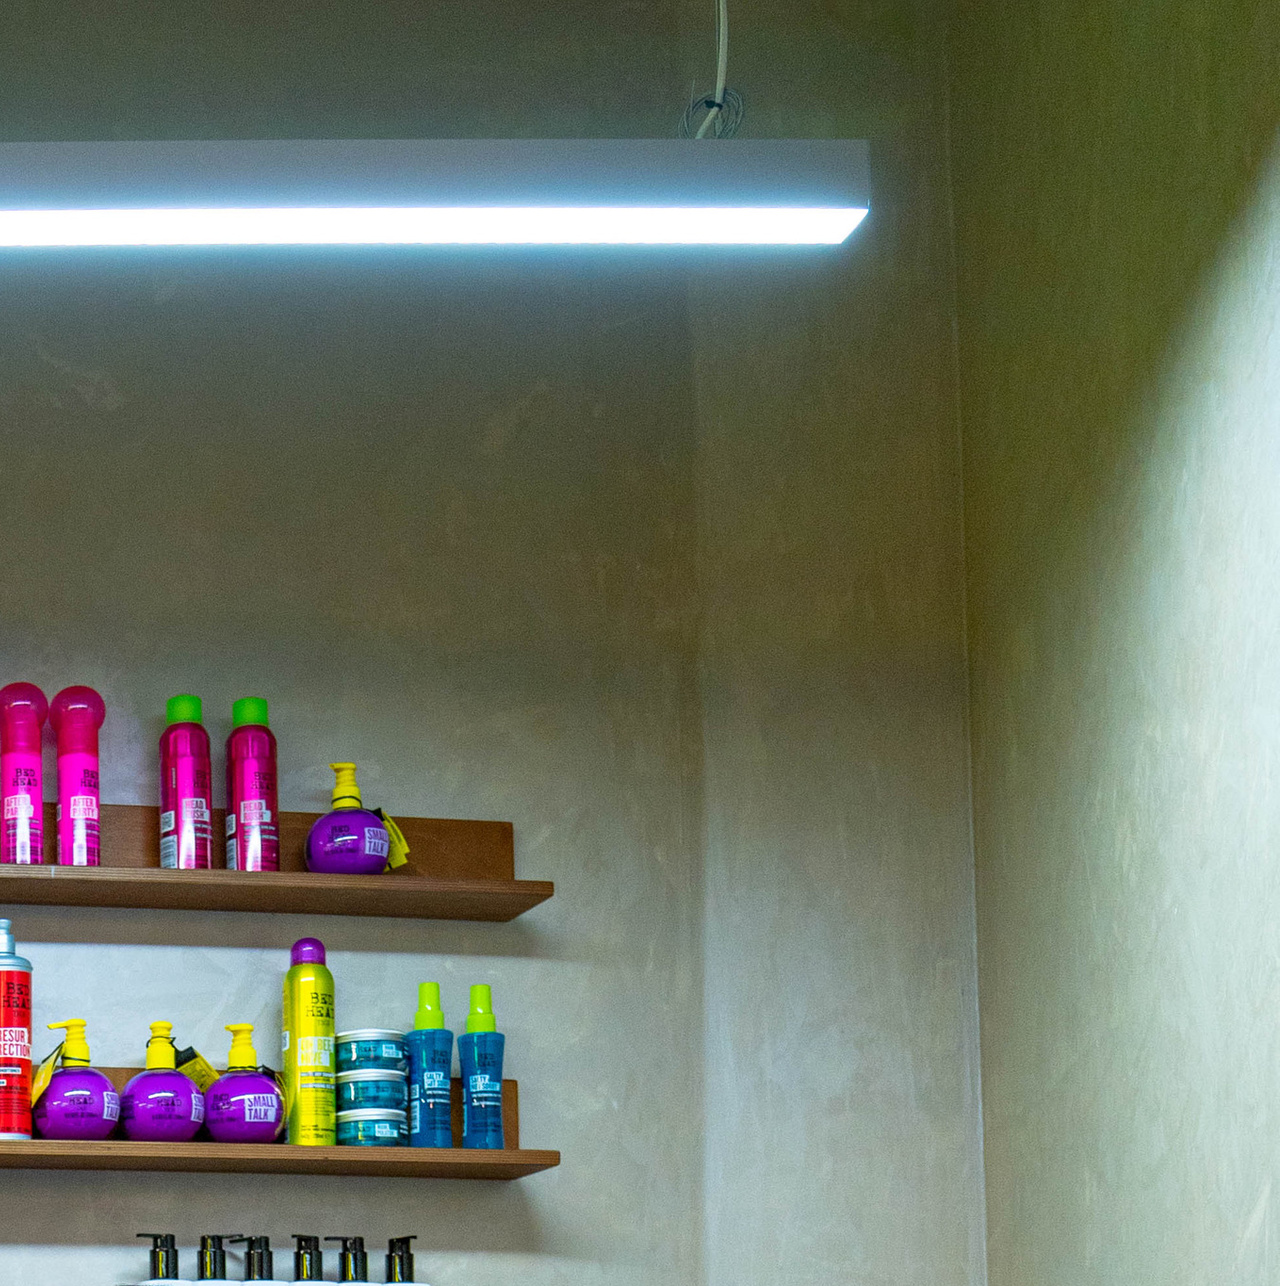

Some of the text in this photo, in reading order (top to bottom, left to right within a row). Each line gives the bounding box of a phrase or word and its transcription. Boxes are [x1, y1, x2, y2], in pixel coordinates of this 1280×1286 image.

[15, 768, 36, 778] BED
[12, 777, 38, 787] HEAD
[71, 807, 96, 817] PARTY
[368, 841, 385, 854] TALK
[6, 982, 30, 995] BED
[247, 1095, 275, 1108] SMALL
[247, 1108, 269, 1120] TALK
